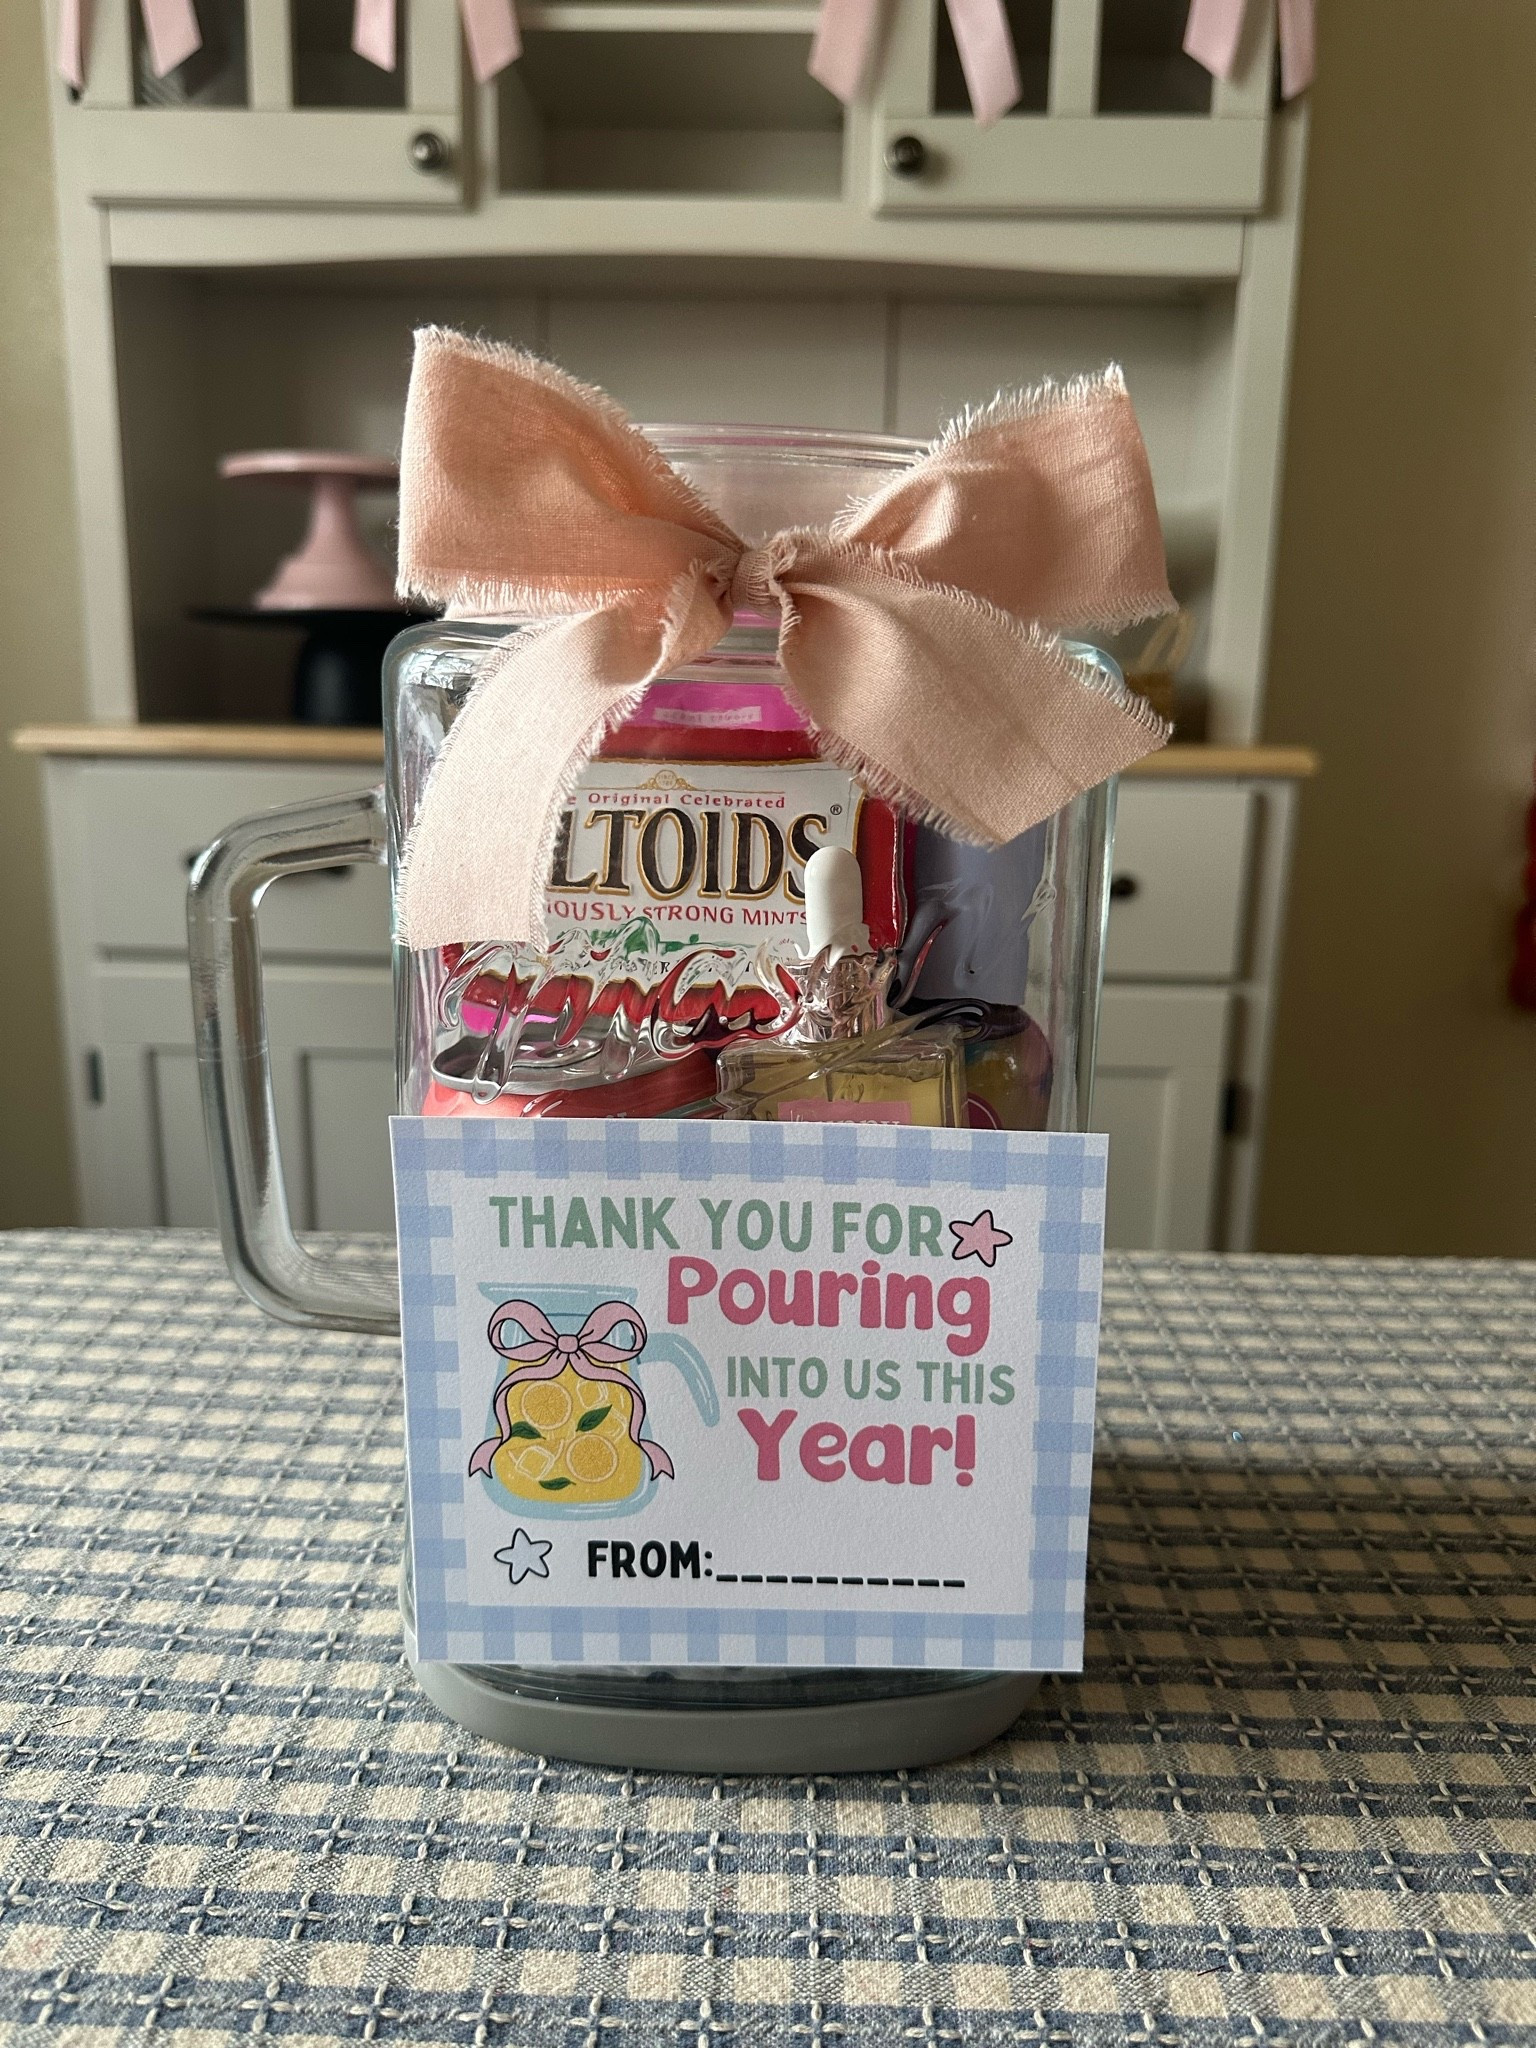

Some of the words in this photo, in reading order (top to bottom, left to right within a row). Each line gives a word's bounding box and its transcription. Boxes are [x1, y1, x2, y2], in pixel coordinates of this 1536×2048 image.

[588, 793, 670, 807] Original
[680, 794, 786, 809] Celebrated
[546, 808, 828, 906] LTOIDS
[547, 899, 636, 921] IOUSLY
[643, 905, 734, 924] STRONG
[489, 1195, 681, 1250] THANK
[700, 1198, 813, 1253] YOU
[832, 1201, 944, 1257] FOR
[667, 1255, 991, 1357] Pouring
[727, 1356, 829, 1398] INTO
[844, 1358, 902, 1401] US
[916, 1361, 1015, 1406] THIS
[737, 1407, 976, 1487] Year!
